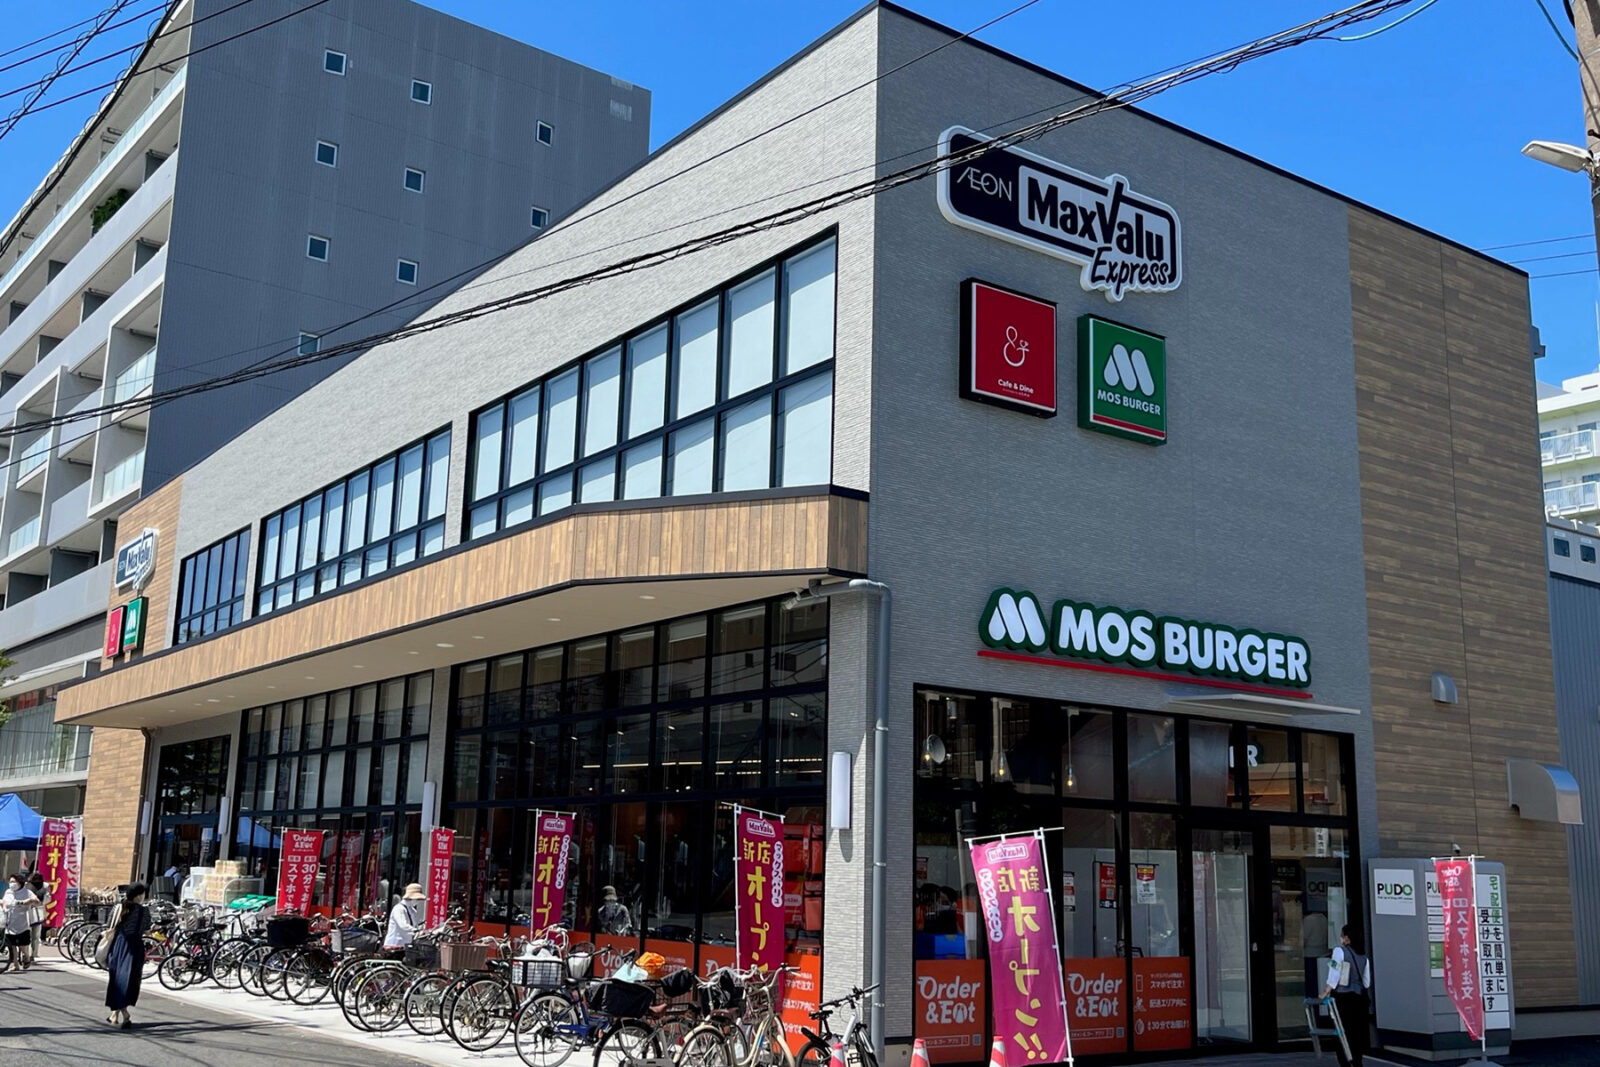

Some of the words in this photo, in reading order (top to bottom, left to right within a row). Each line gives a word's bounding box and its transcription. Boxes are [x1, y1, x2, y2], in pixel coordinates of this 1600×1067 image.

[1027, 180, 1164, 262] MaxValu
[1091, 246, 1169, 295] Express
[998, 379, 1012, 389] Cafe
[1019, 385, 1034, 394] Dine
[1097, 389, 1121, 405] MOS
[1123, 396, 1161, 416] BURGER
[1059, 605, 1156, 661] MOS
[1164, 622, 1308, 682] BURGER
[293, 834, 317, 843] Order
[749, 821, 773, 834] MaxValu
[45, 834, 65, 847] 新店
[538, 835, 560, 854] 新店
[743, 838, 771, 865] 新店
[773, 842, 783, 905] マックスバリュ
[537, 857, 554, 937] オープ
[1377, 883, 1412, 896] PUDO
[1480, 909, 1495, 1010] 受け取れます
[918, 976, 980, 999] Order
[1067, 973, 1122, 995] Order
